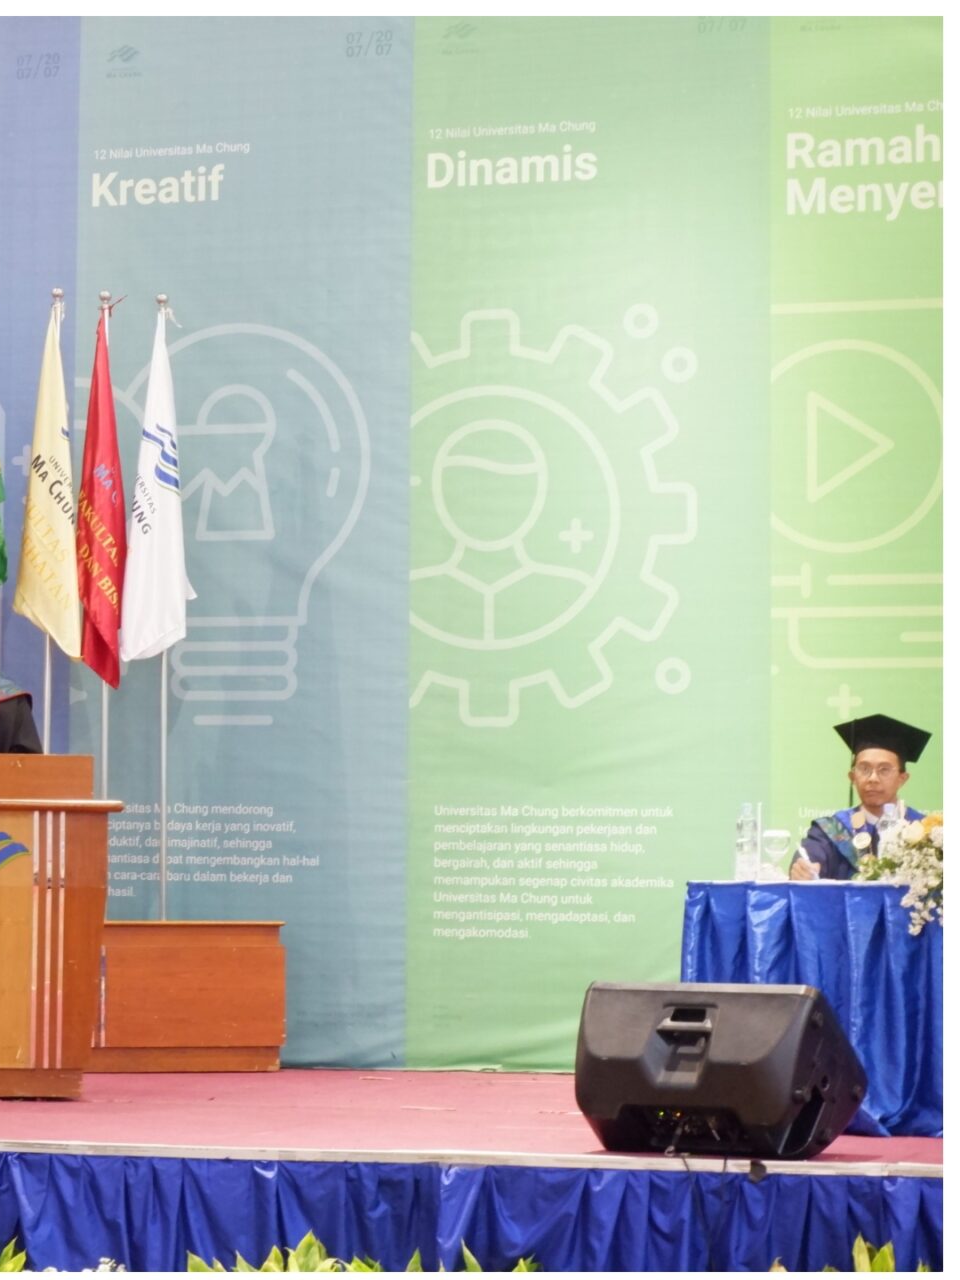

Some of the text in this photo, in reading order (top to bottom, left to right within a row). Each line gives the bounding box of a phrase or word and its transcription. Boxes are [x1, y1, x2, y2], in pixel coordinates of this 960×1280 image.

[429, 119, 596, 139] 12 Nilai Universitas Ma Chung
[94, 141, 250, 160] 12 Nilai Universitas Ma Chung
[786, 125, 941, 169] Ramah
[426, 144, 598, 188] Dinamis
[92, 164, 224, 207] Kreatif
[173, 802, 273, 817] Chung mendorong
[194, 820, 296, 834] kerja yang inovatif,
[167, 836, 272, 852] imajinatif, sehingga
[185, 855, 320, 868] mengembangkan hal-hal
[192, 870, 227, 881] dalam
[229, 871, 269, 884] bekerja
[271, 872, 293, 882] dan
